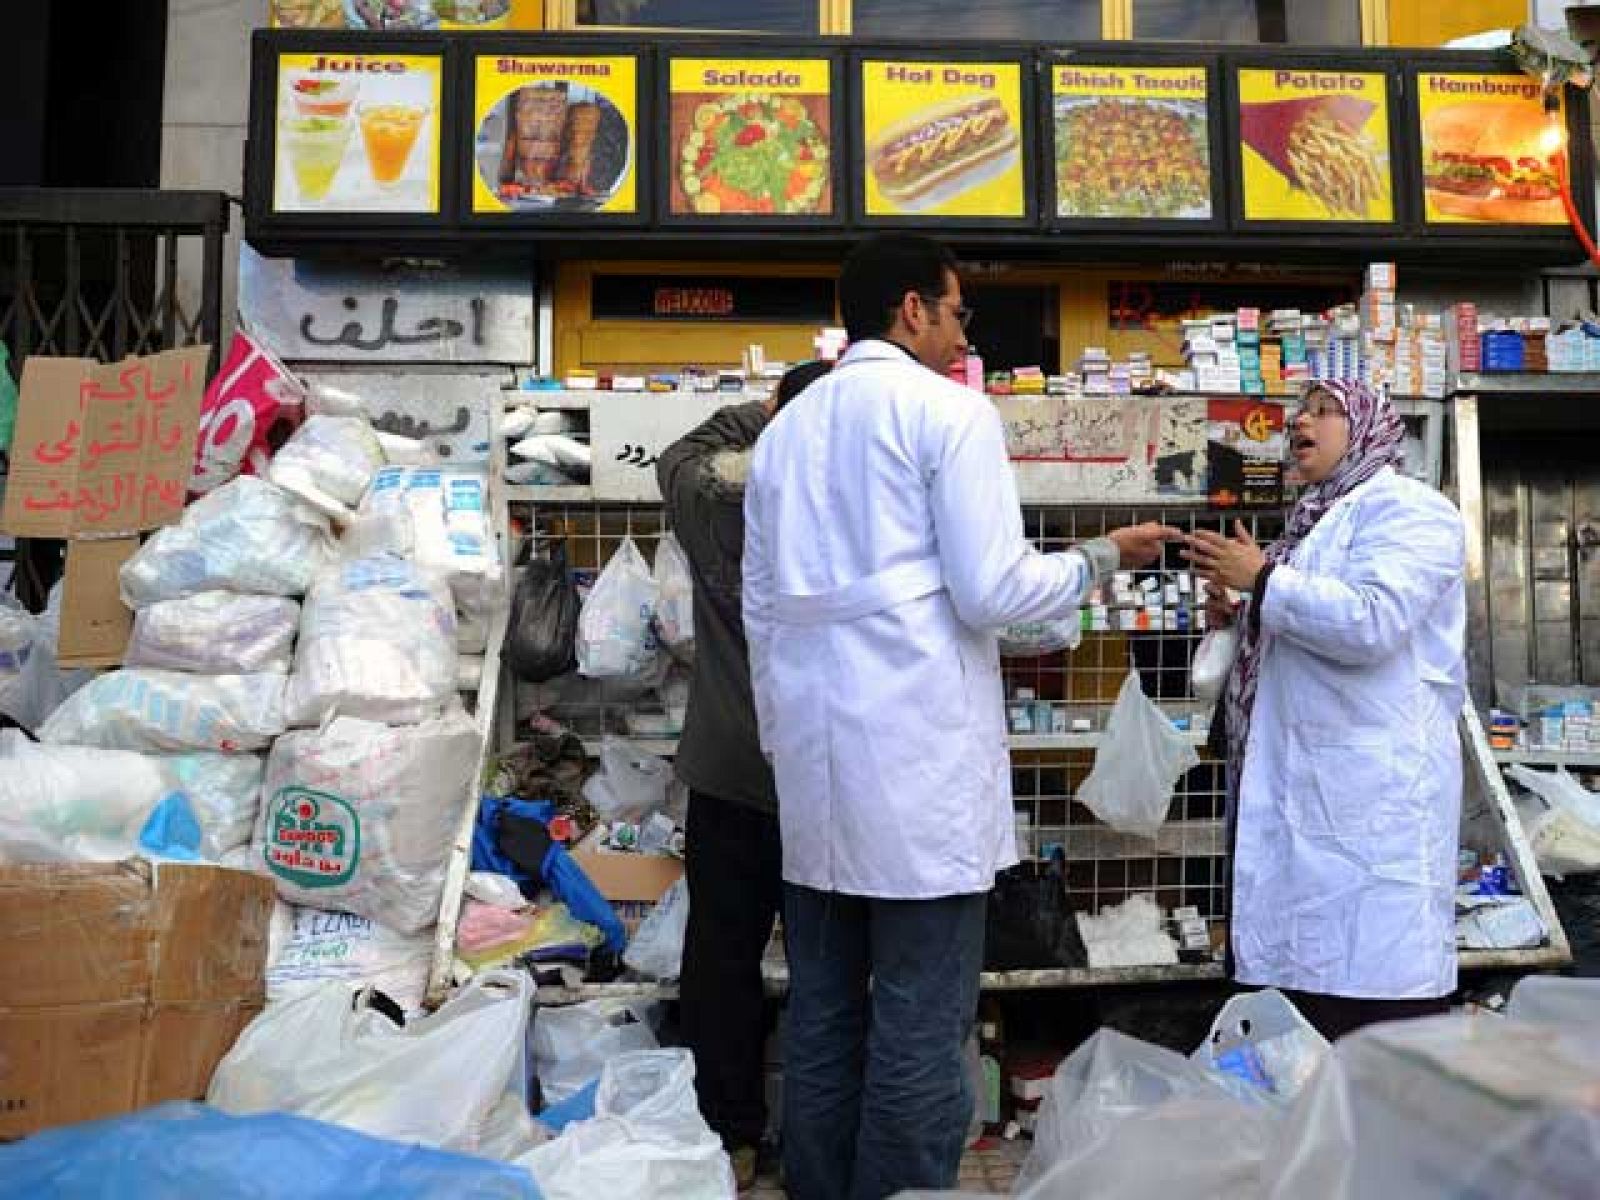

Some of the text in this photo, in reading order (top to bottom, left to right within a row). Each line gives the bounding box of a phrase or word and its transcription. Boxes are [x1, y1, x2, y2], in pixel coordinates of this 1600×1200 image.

[308, 56, 408, 74] Juice
[496, 58, 612, 78] Shawarma
[703, 69, 803, 88] Salada
[885, 65, 997, 89] Hot Dog
[1059, 68, 1126, 90] Shish
[1273, 69, 1366, 92] Potato
[1428, 75, 1541, 101] Hamburg
